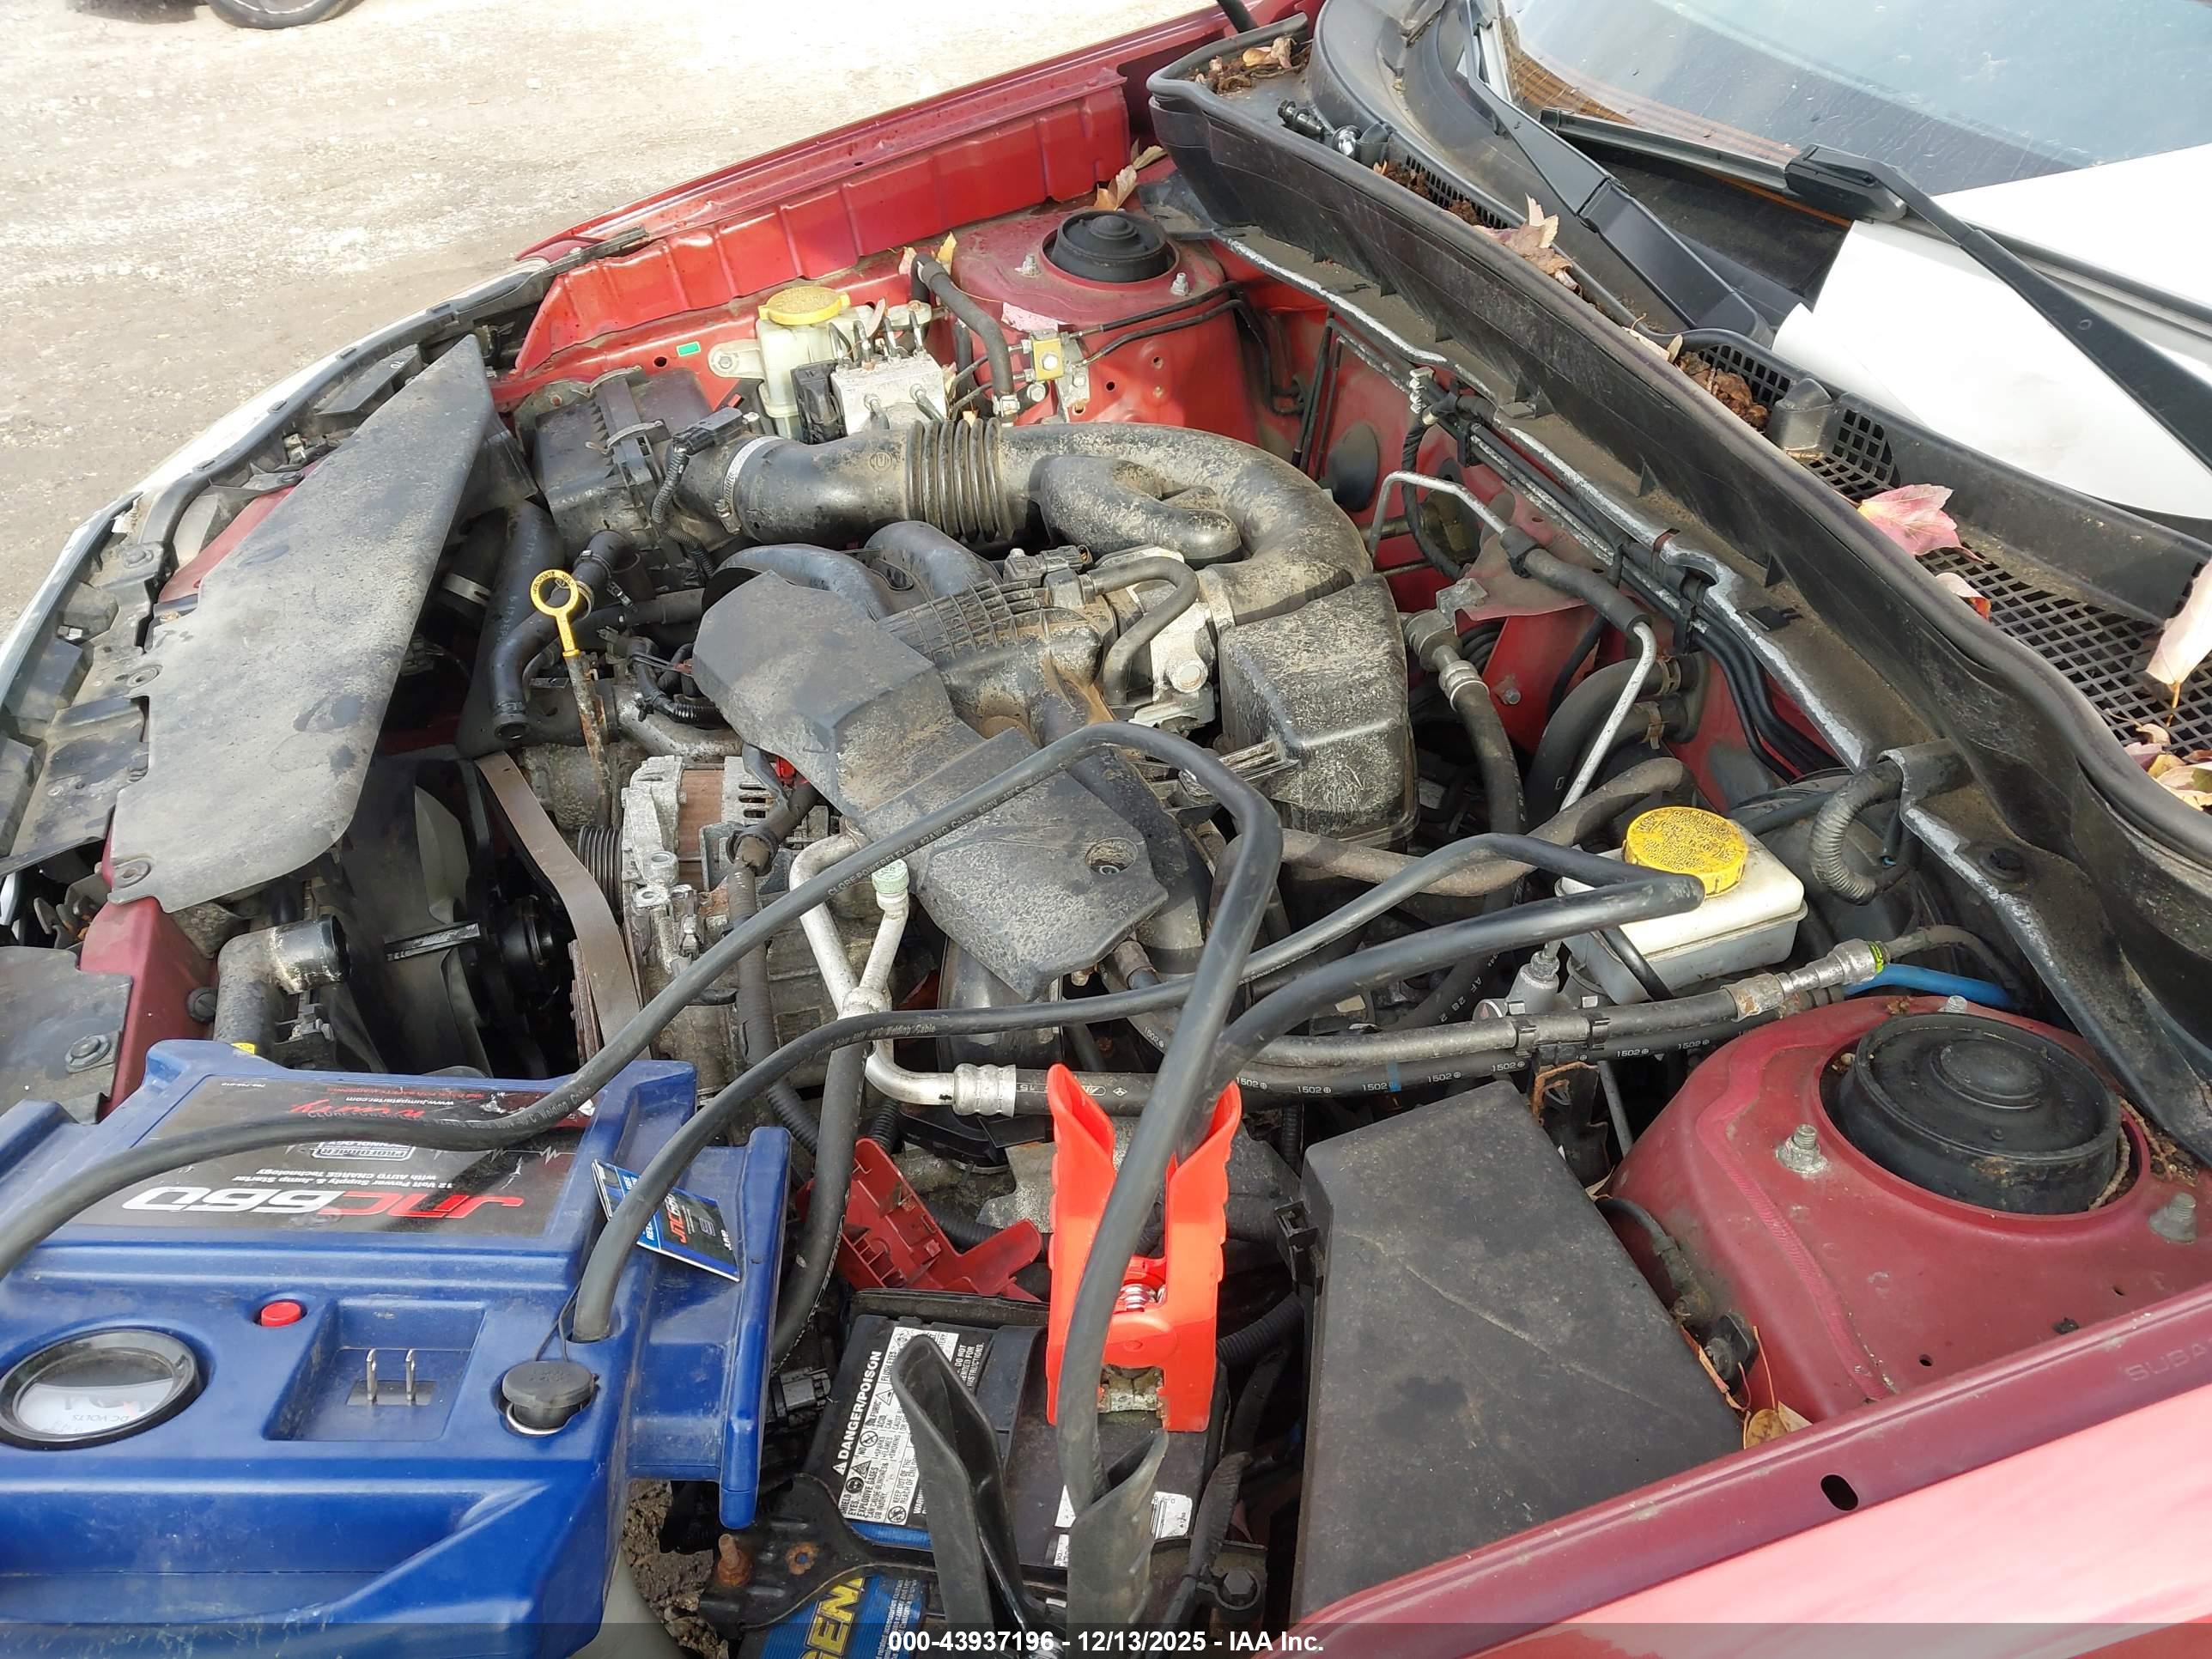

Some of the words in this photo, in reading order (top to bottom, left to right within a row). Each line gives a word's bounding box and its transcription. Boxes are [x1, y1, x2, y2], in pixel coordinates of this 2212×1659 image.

[1427, 1072, 1453, 1083] 1502
[1297, 1085, 1323, 1095] 1502
[1362, 1082, 1389, 1091] 1502
[345, 1095, 453, 1107] www.jumpstarter.com
[255, 1166, 324, 1178] Technology
[326, 1170, 374, 1180] CHARGE
[376, 1171, 408, 1181] AUTO
[410, 1173, 435, 1182] with
[231, 1173, 275, 1184] Starter
[276, 1173, 313, 1185] Jump
[327, 1175, 374, 1187] Supply
[375, 1179, 410, 1188] Power
[411, 1180, 435, 1189] Volt
[965, 1345, 975, 1358] FOR
[835, 1349, 884, 1462] DANGER/POISON
[900, 1468, 908, 1477] OF
[840, 1493, 852, 1514] SHIELD
[857, 1445, 866, 1455] NO
[896, 1477, 906, 1489] OUT
[855, 1485, 873, 1517] EXPLOSIVE
[866, 1465, 878, 1486] GASES
[892, 1488, 902, 1503] KEEP
